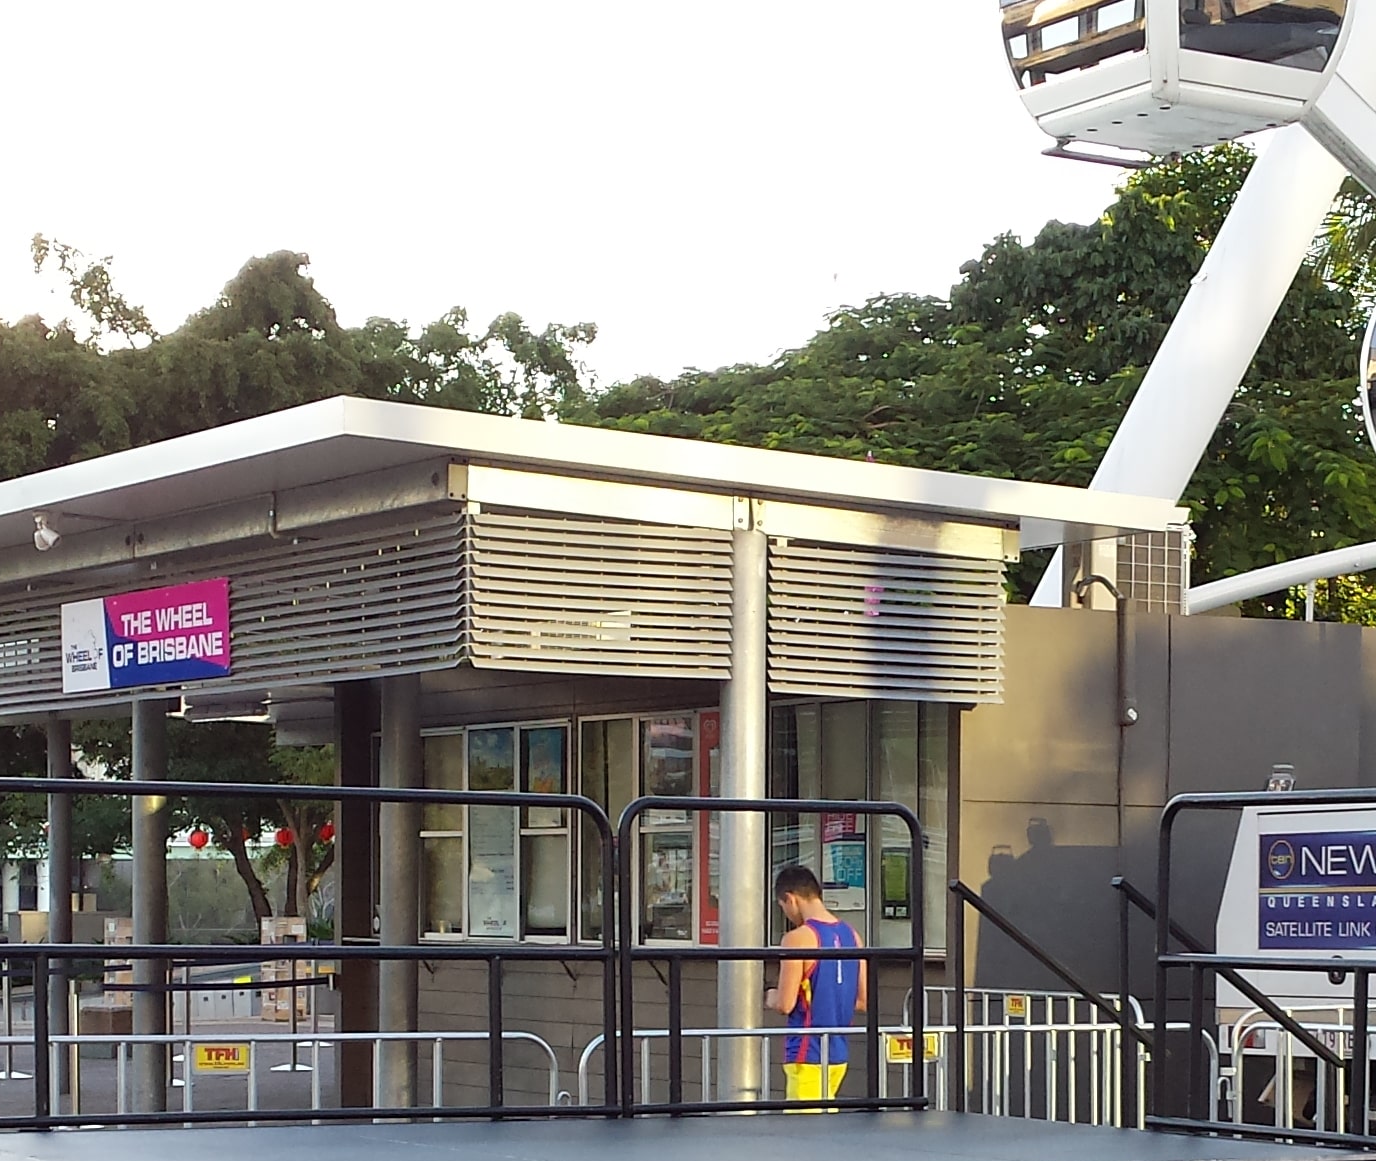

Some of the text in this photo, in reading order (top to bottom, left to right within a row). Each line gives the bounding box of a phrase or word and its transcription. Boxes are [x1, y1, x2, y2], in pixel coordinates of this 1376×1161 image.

[121, 602, 213, 637] THE WHEEL
[65, 650, 92, 664] WHEEL
[112, 631, 224, 668] OF BRISBANE
[836, 868, 863, 881] OFF
[1266, 921, 1332, 937] SATELLITE
[1338, 921, 1371, 936] LINK
[204, 1047, 238, 1061] TFH
